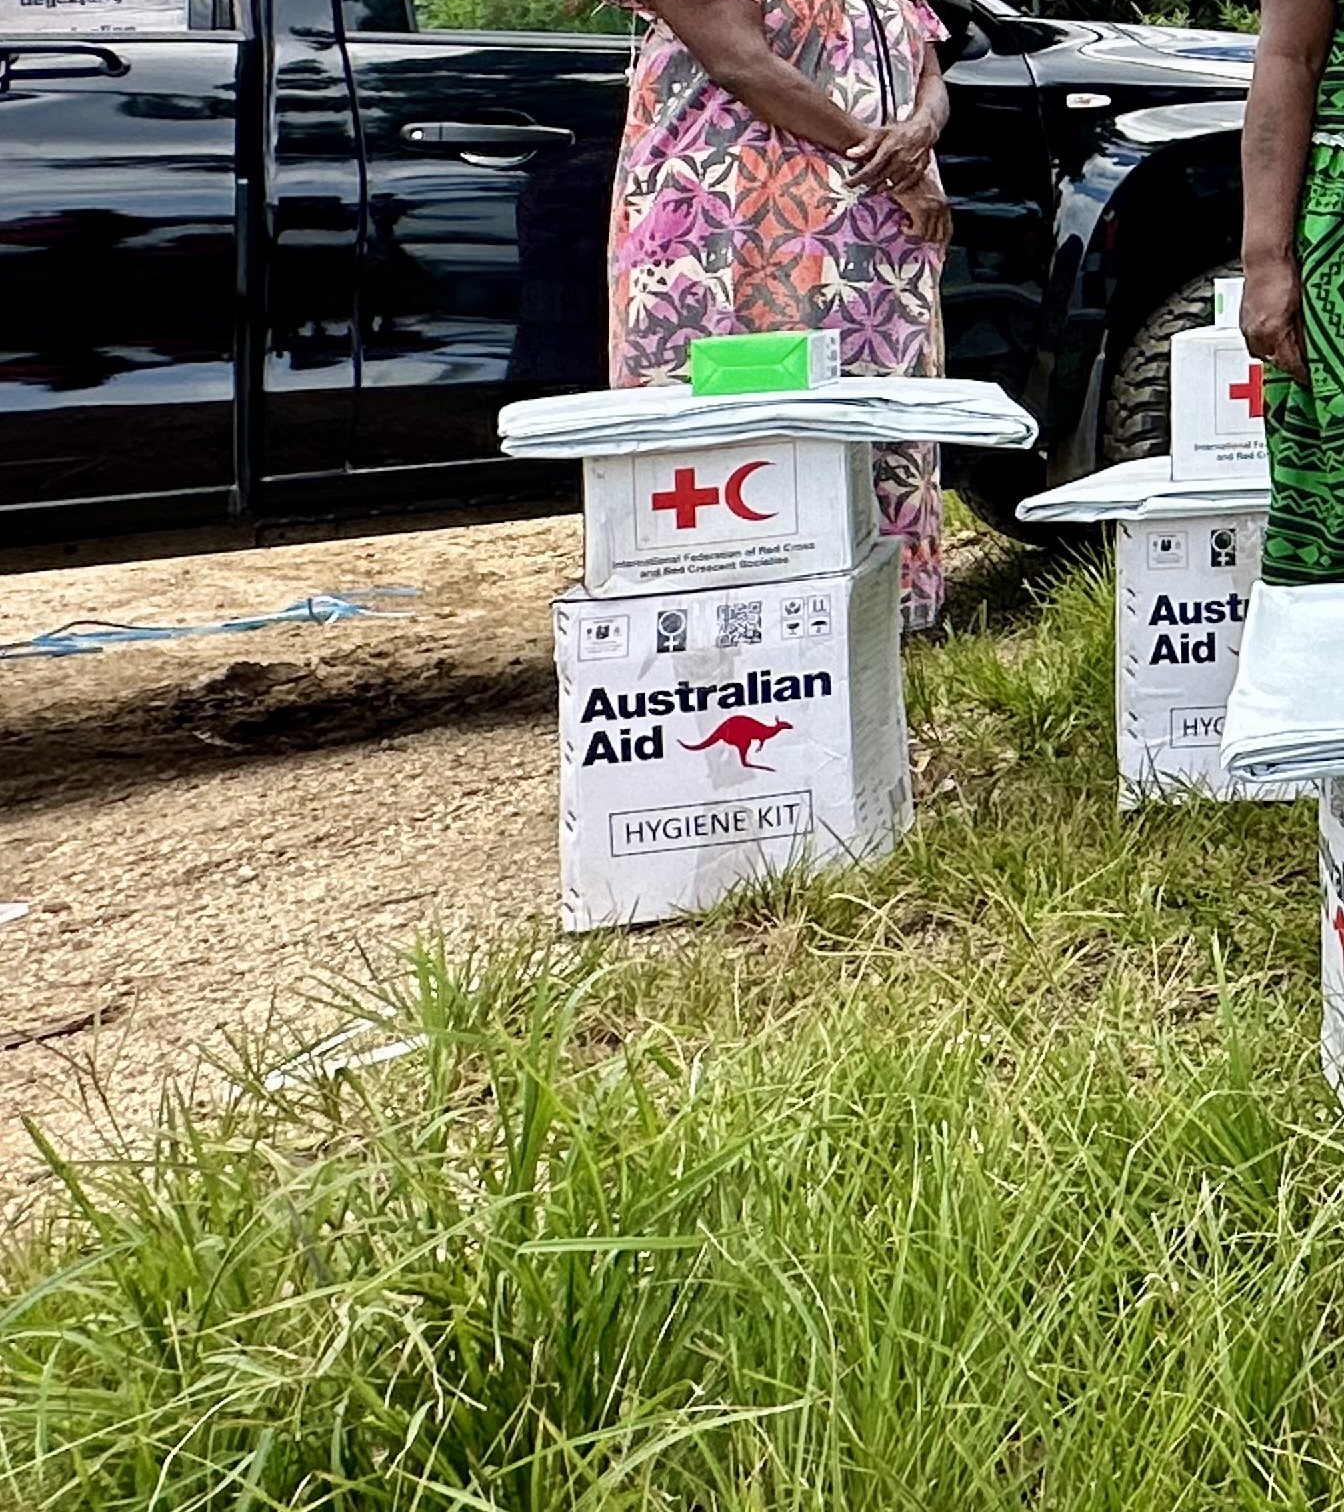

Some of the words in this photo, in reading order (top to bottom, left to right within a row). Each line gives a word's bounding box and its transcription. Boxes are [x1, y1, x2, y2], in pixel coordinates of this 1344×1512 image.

[1149, 632, 1216, 665] Aid
[580, 669, 832, 724] Australian
[582, 725, 664, 767] Aid
[625, 810, 747, 844] HYGIENE
[758, 803, 800, 830] KIT
